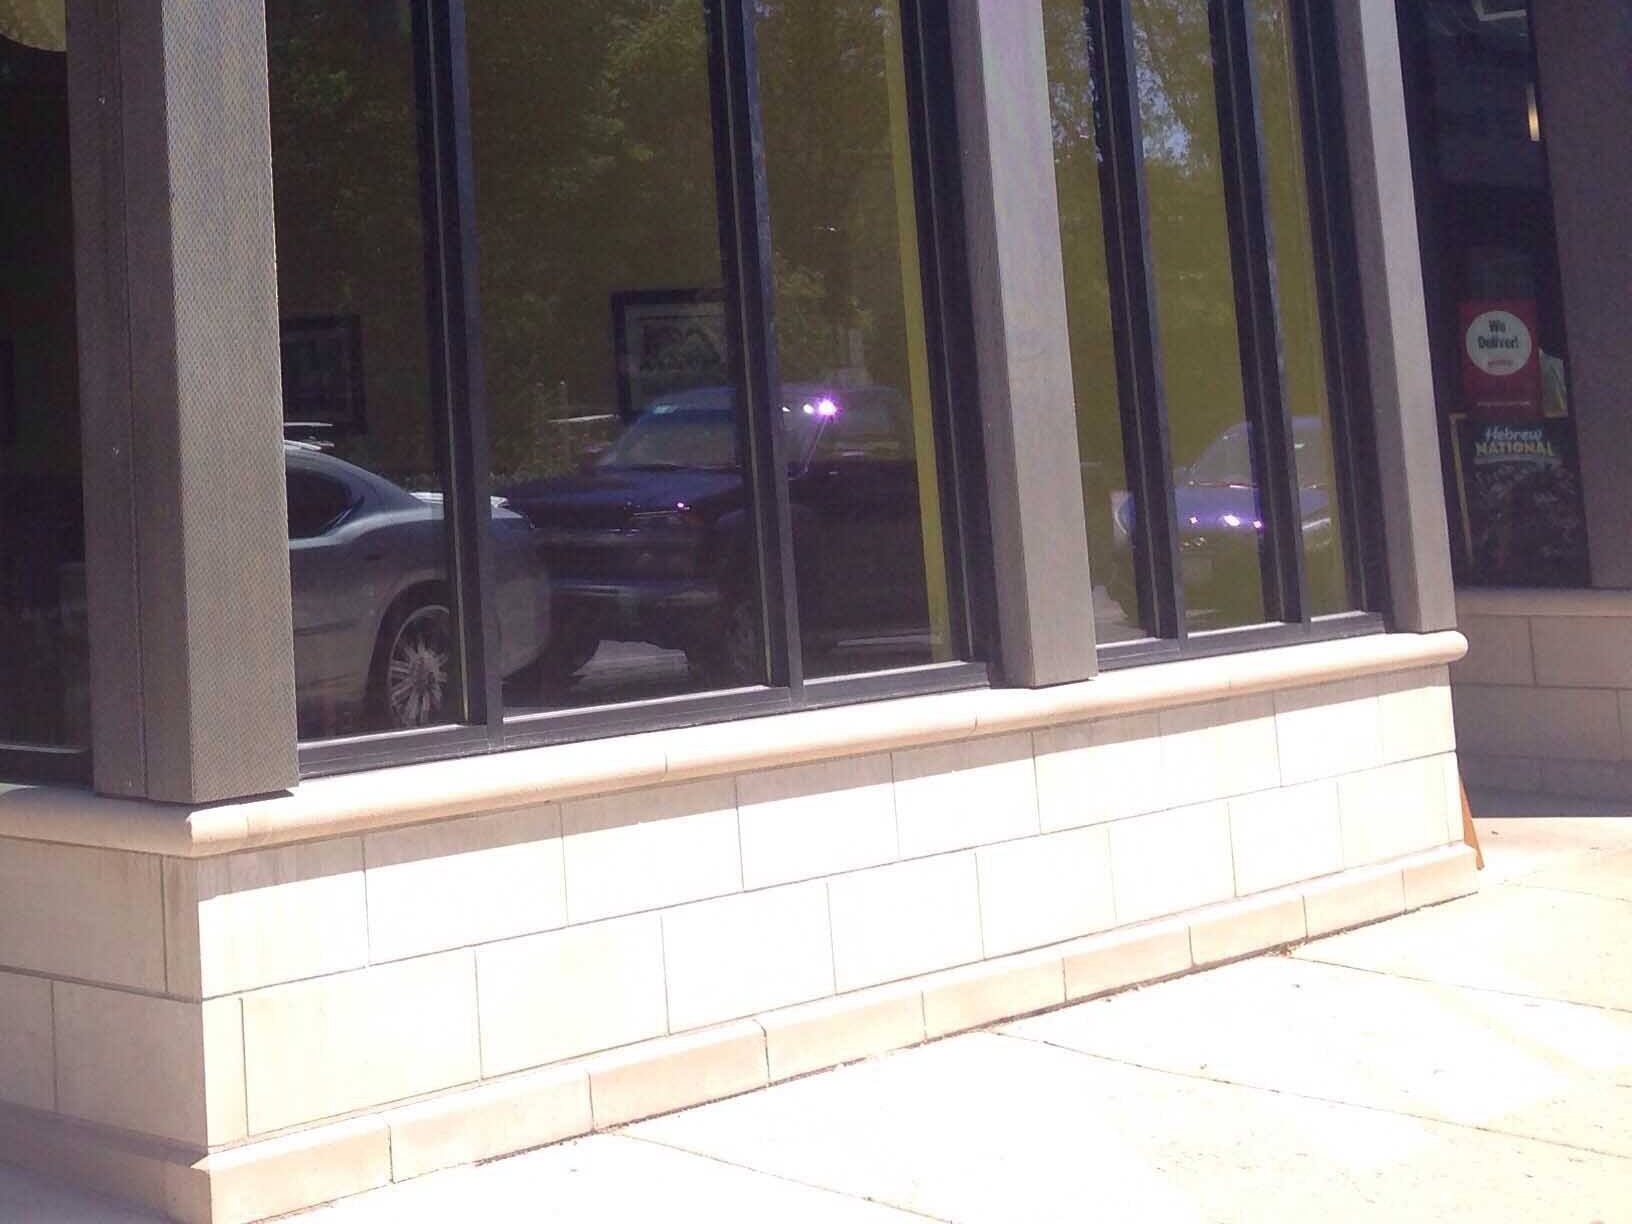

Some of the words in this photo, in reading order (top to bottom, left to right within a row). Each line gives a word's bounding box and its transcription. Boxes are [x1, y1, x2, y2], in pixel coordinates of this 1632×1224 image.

[1488, 319, 1507, 333] We
[1477, 335, 1520, 350] Deliver!
[1485, 423, 1544, 443] Hebrew
[1474, 440, 1555, 458] NATIONAL
